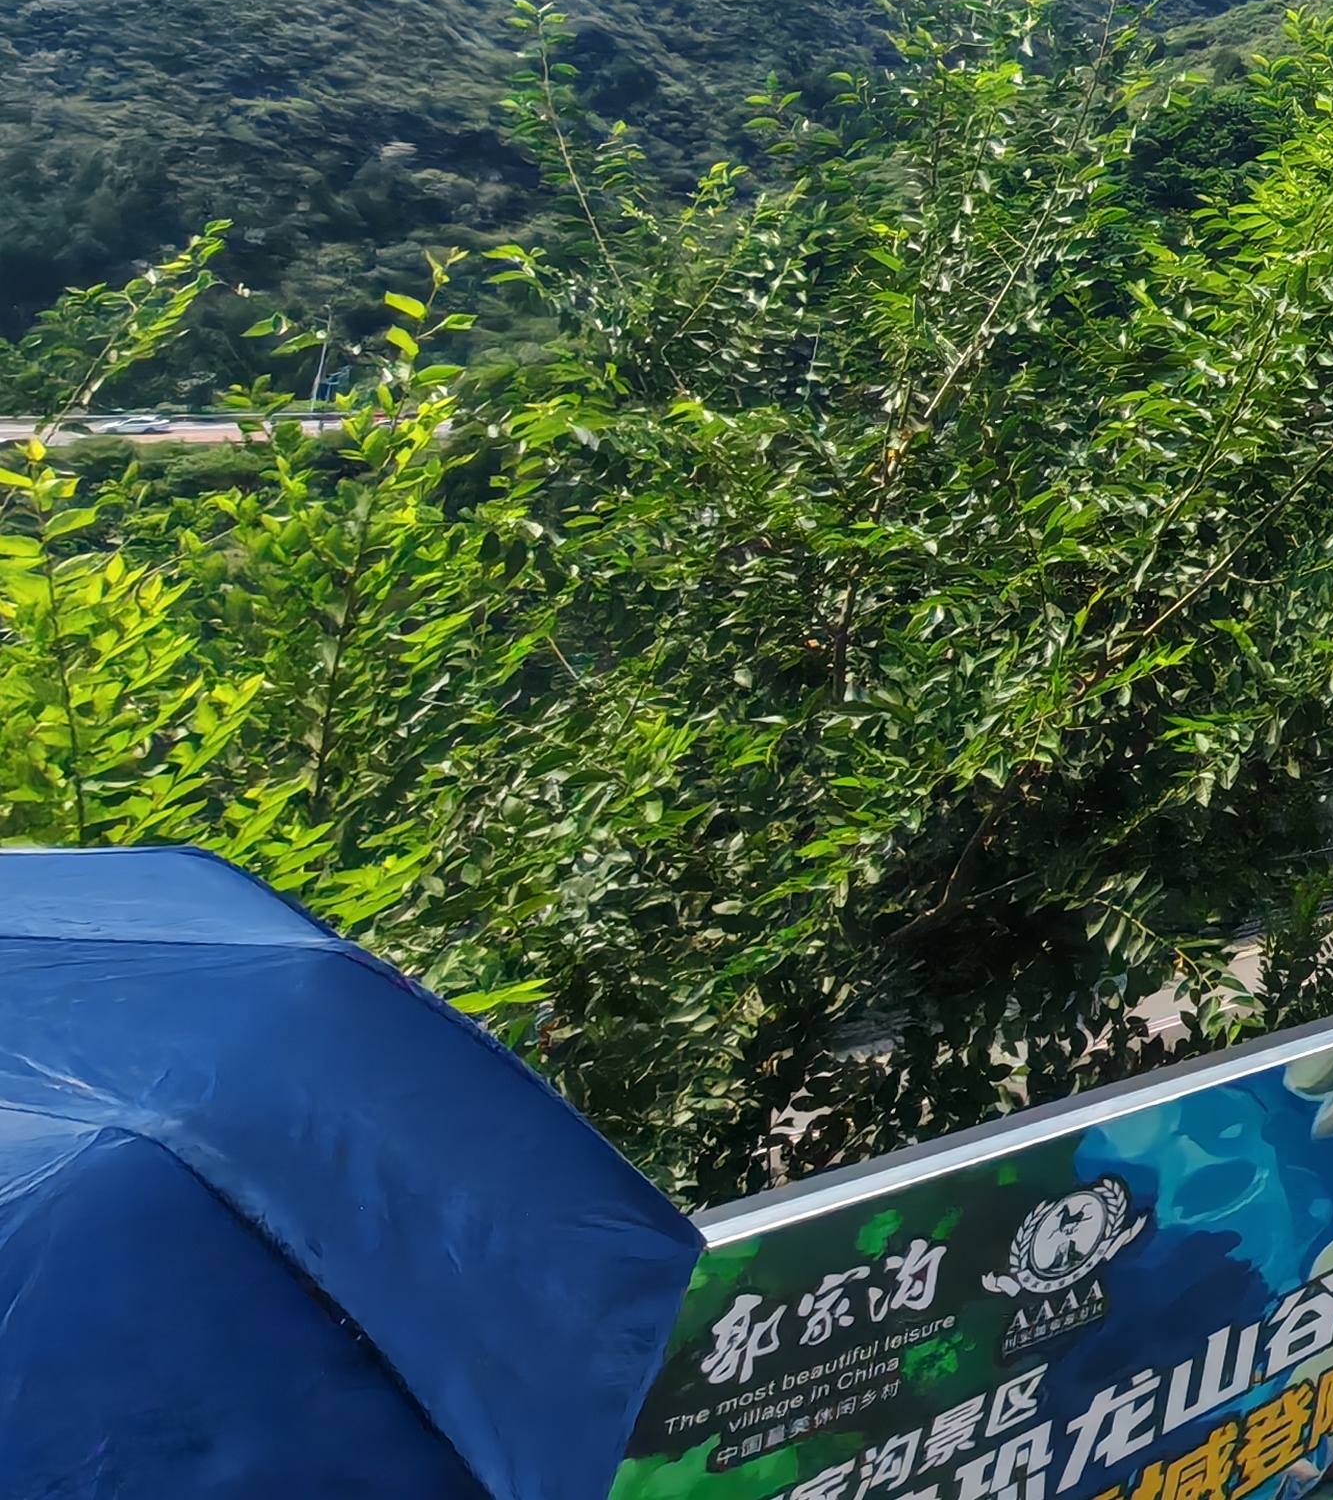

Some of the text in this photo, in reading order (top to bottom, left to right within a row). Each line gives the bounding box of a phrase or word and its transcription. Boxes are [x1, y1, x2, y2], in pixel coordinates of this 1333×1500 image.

[664, 1315, 956, 1435] The most beautiful leisure
[701, 1238, 947, 1384] 郭家沟
[727, 1357, 899, 1433] village in China
[770, 1364, 1046, 1500] 家沟景区
